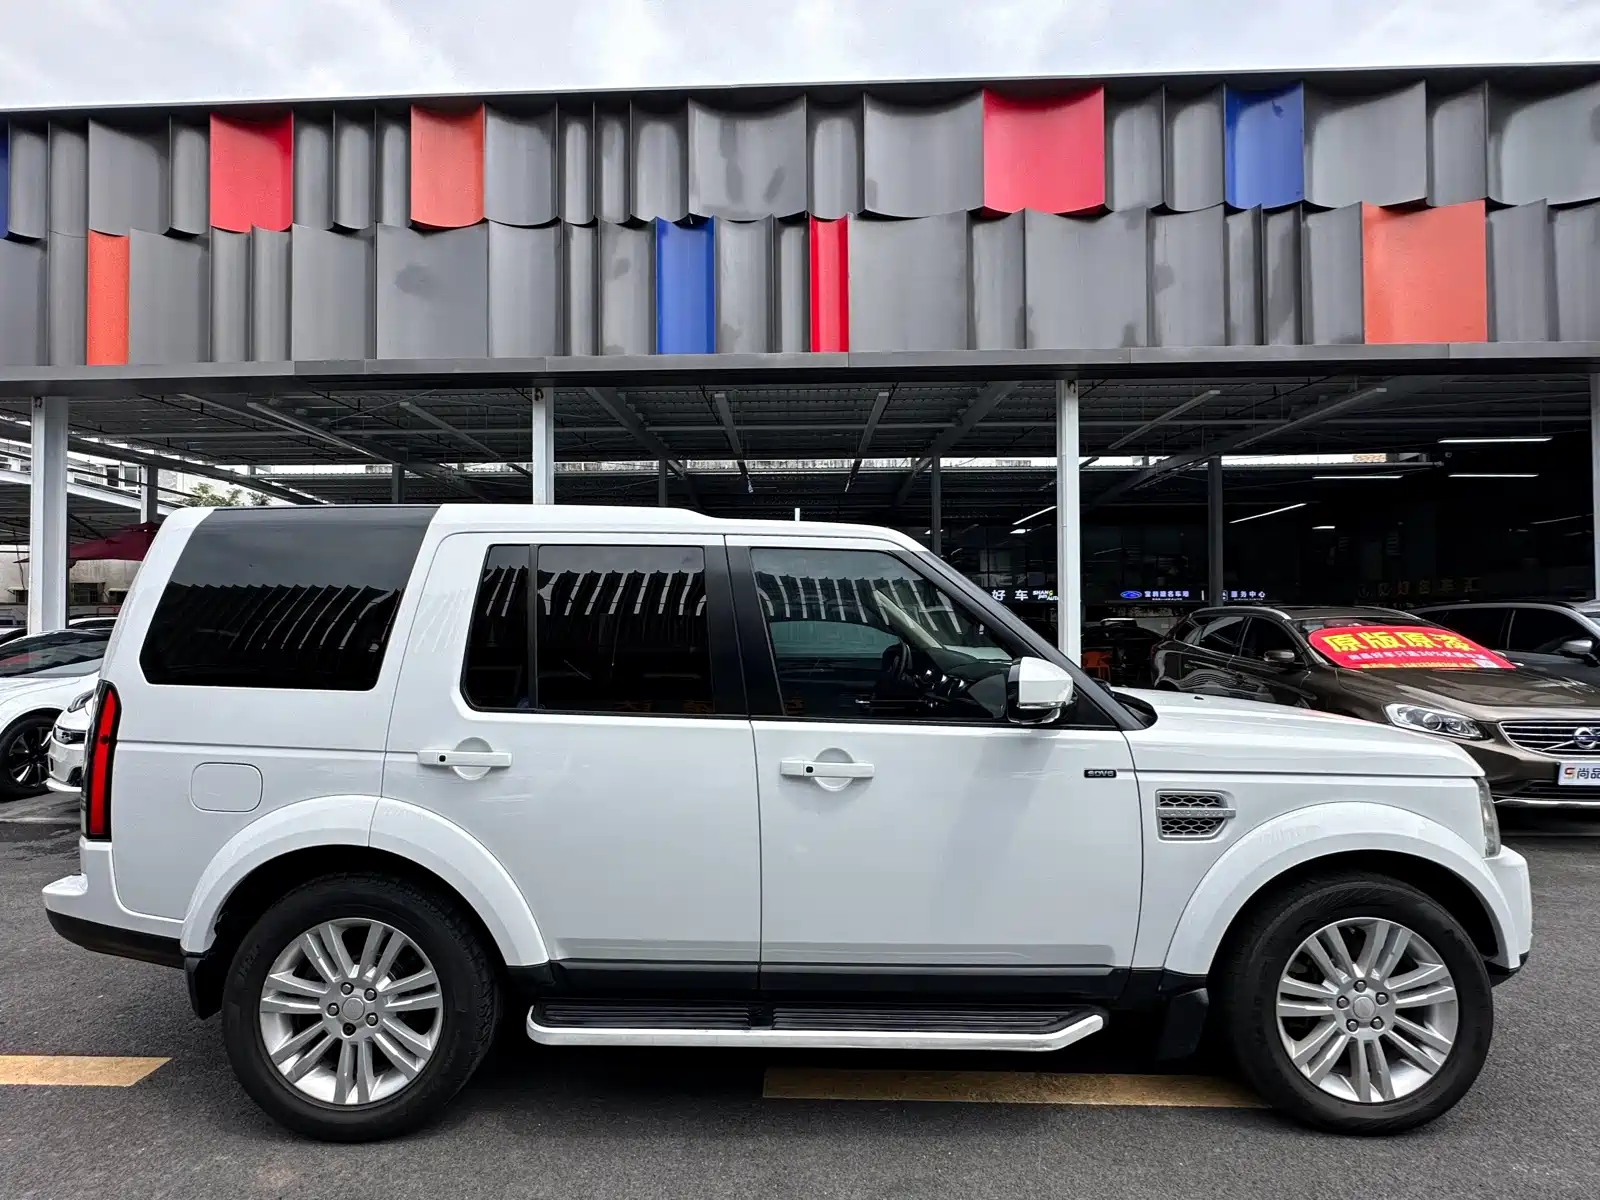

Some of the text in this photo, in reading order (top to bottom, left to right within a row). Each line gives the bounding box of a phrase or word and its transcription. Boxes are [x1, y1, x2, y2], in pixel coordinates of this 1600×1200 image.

[992, 589, 1028, 601] 好车
[1323, 631, 1475, 652] 原版原漆
[1577, 767, 1600, 780] 尚品
